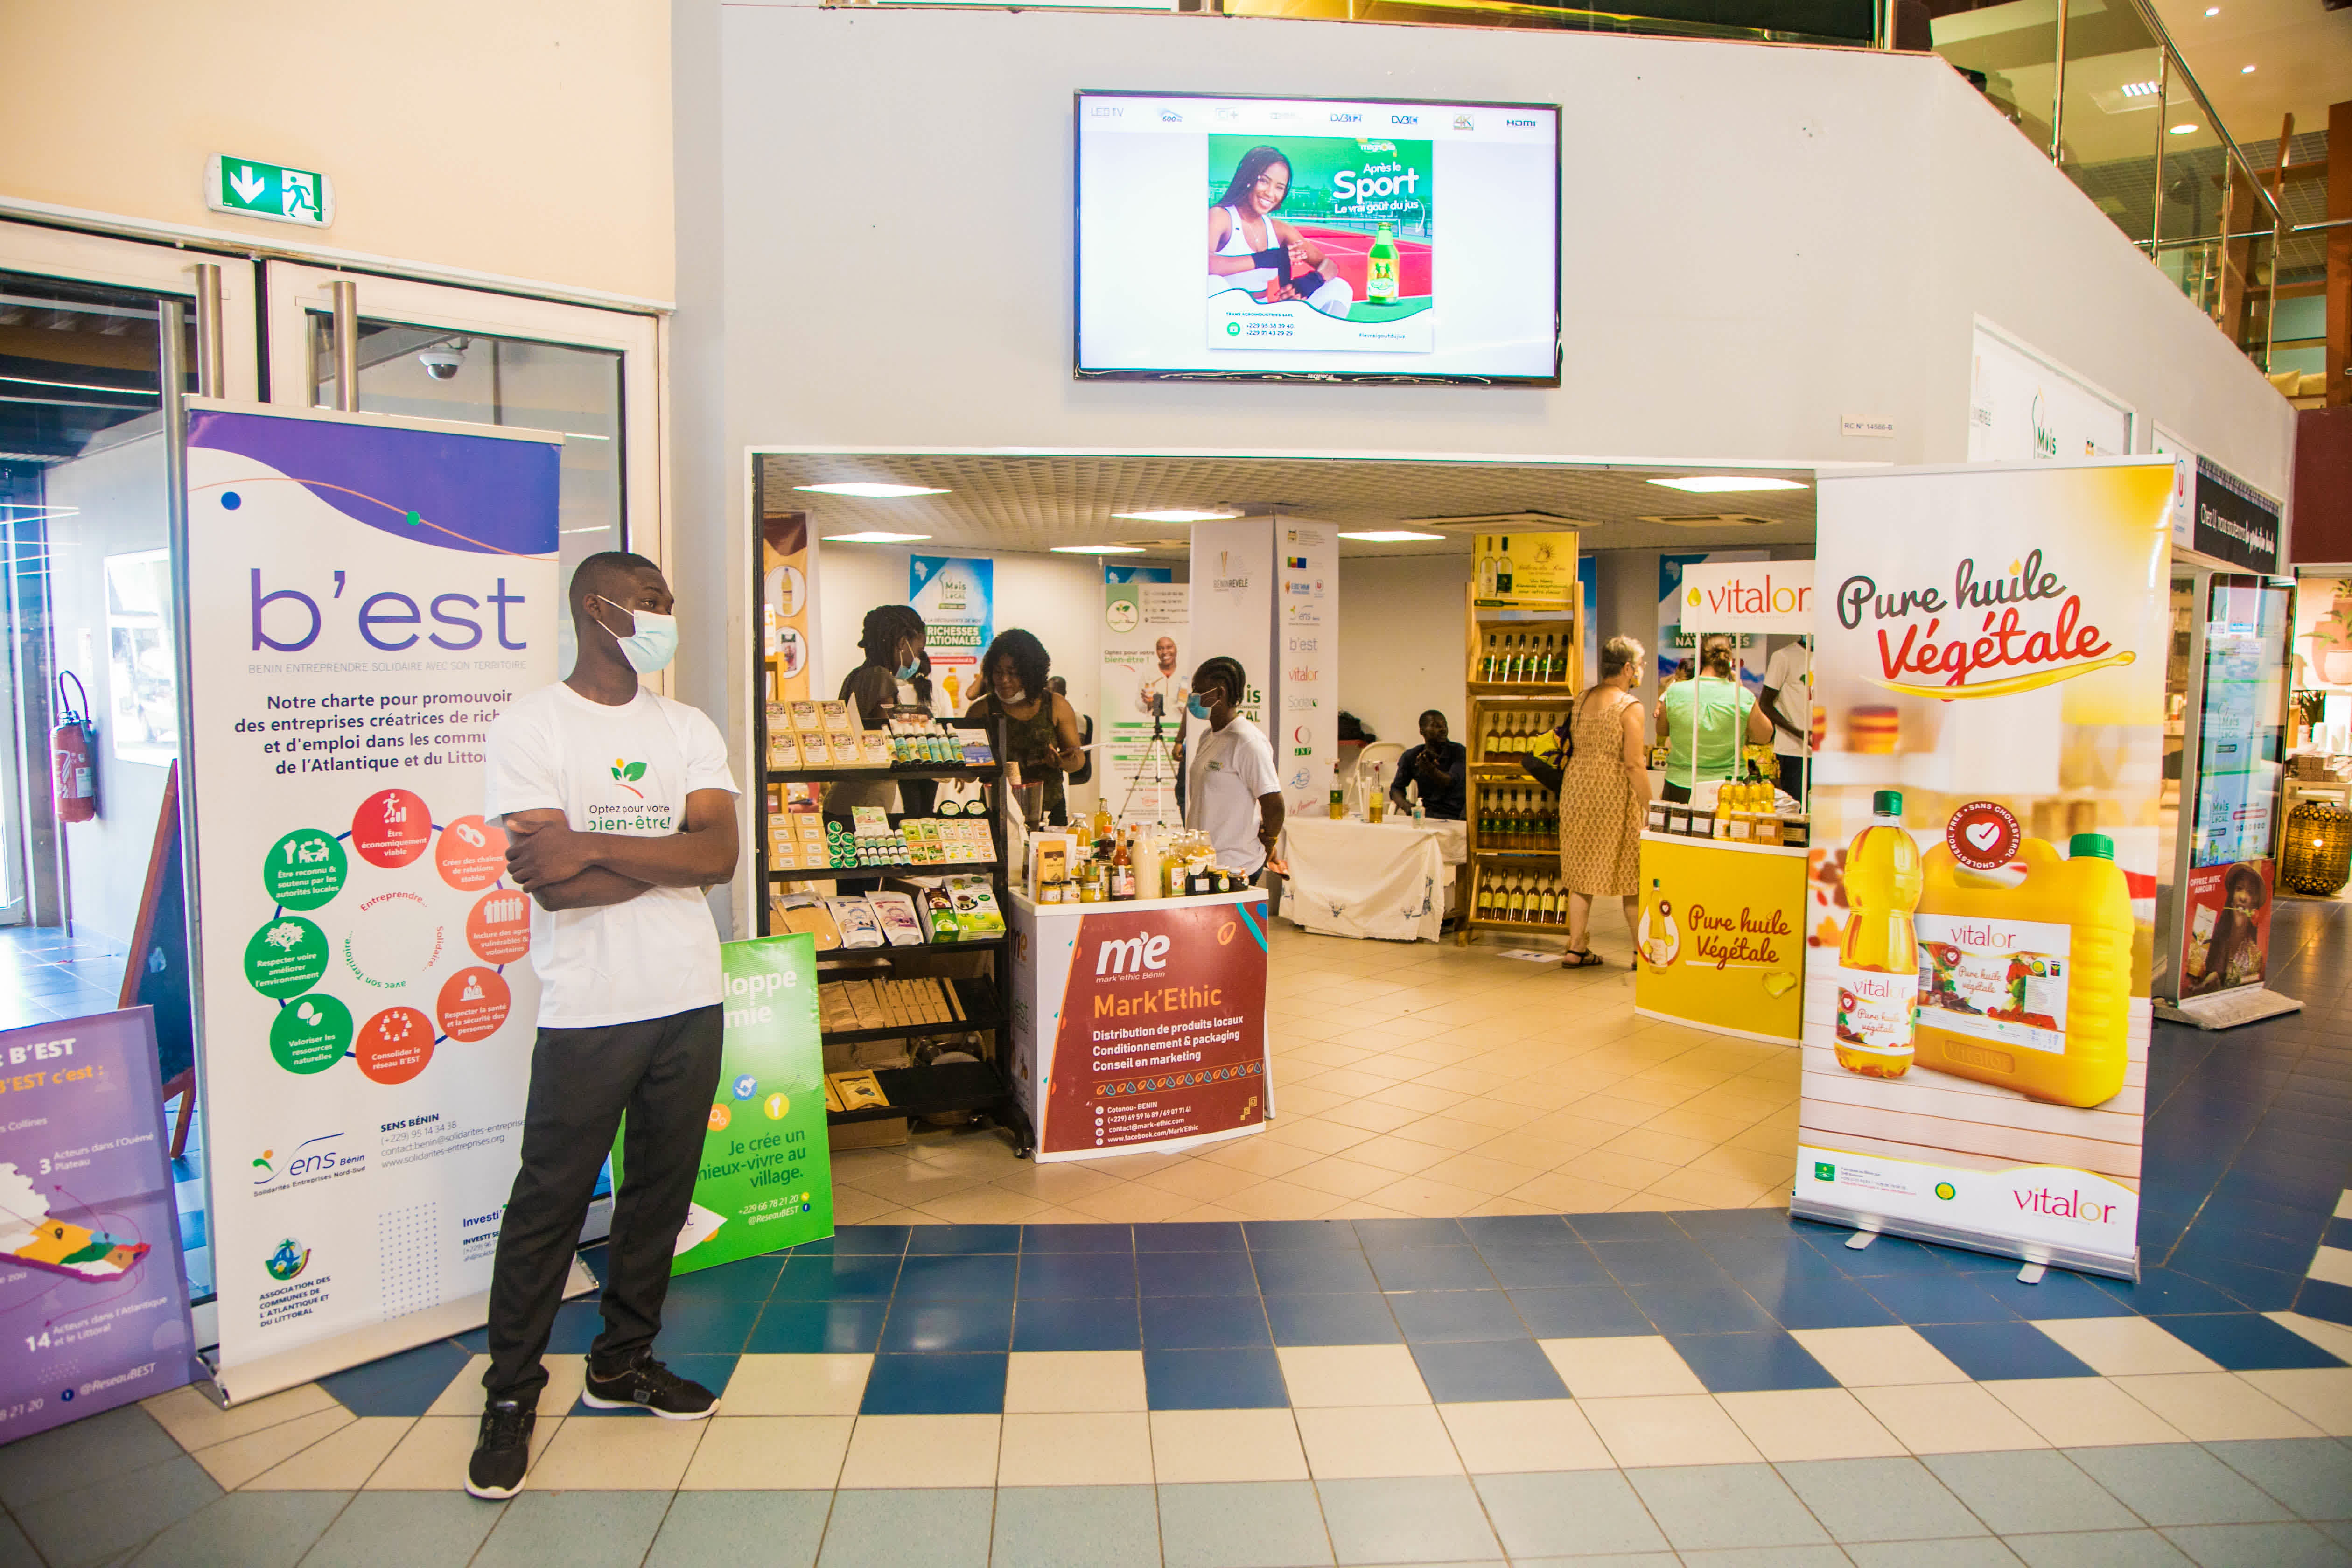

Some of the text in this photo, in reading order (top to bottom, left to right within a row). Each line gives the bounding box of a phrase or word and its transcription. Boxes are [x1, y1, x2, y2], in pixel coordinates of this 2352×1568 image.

[1363, 161, 1401, 175] Après le
[1333, 168, 1419, 204] Sport
[1335, 199, 1419, 214] Le vrai goût du jus
[1708, 574, 1811, 614] vitalor
[1837, 548, 2067, 629] Pure huile
[251, 568, 526, 652] b'est
[927, 627, 978, 636] RICHESSES
[1878, 595, 2112, 702] Végétale
[249, 661, 526, 674] BENIN ENTREPRENDRE SOLIDAIRE AVEC SON TERRITOIRE
[1289, 666, 1318, 682] vitalor
[267, 690, 512, 709] Notre charte pour promouvoir
[235, 718, 265, 733] des
[271, 715, 364, 732] entreprises
[370, 713, 444, 727] créatrices
[450, 711, 468, 723] de
[264, 733, 429, 753] et d'emploi dans les
[276, 752, 442, 774] de l'Atlantique et du
[589, 805, 620, 815] Optez
[623, 805, 643, 814] pour
[1949, 812, 1963, 831] FREE
[1995, 806, 2019, 857] CHOLESTEROL
[362, 838, 427, 849] économiquement
[1949, 834, 1995, 868] CHOLESTEROL
[295, 867, 327, 876] reconnu
[278, 880, 308, 888] soutenu
[311, 878, 323, 886] par
[2190, 877, 2207, 886] OFFREZ
[276, 885, 339, 898] autorités locales
[1688, 905, 1792, 936] Pure huile
[1951, 925, 2016, 949] vitalor
[257, 956, 295, 967] Respecter
[1697, 936, 1780, 970] Végétale
[256, 972, 319, 987] l'environnement
[269, 965, 305, 975] améliorer
[1096, 973, 1140, 983] mark'ethic
[366, 977, 381, 987] son
[1853, 980, 1907, 998] vitalor
[1094, 984, 1221, 1018] Mark'Ethic
[1093, 1016, 1243, 1041] Distribution de produits locaux
[9, 1038, 76, 1064] B'EST
[289, 1036, 322, 1047] Valoriser
[292, 1044, 333, 1056] ressources
[1093, 1030, 1239, 1057] Conditionnement & packaging
[294, 1054, 332, 1065] naturelles
[372, 1049, 412, 1060] Consolider
[1093, 1051, 1201, 1071] Conseil en marketing
[52, 1065, 93, 1084] c'est
[373, 1060, 398, 1070] réseau
[381, 1113, 439, 1132] SENS BÉNIN
[1108, 1114, 1127, 1124] (+229)
[1109, 1118, 1184, 1133] contact@mark-ethic.com
[728, 1130, 805, 1156] Je crée un
[340, 1155, 364, 1166] Bénin
[788, 1148, 806, 1162] au
[39, 1158, 51, 1175] 3
[55, 1159, 90, 1171] Plateau
[254, 1166, 365, 1197] Solidarités Entreprises Nord-Sud
[750, 1168, 803, 1187] village.
[739, 1205, 757, 1214] +229
[758, 1202, 767, 1211] 66
[779, 1197, 787, 1206] 21
[790, 1195, 798, 1204] 20
[2013, 1187, 2116, 1224] vitalor
[748, 1206, 799, 1225] @ReseauBEST
[260, 1276, 330, 1300] ASSOCIATION DES
[260, 1291, 308, 1309] COMMUNES
[260, 1297, 317, 1318] L'ATLANTIQUE
[275, 1307, 313, 1323] LITTORAL
[26, 1332, 51, 1352] 14
